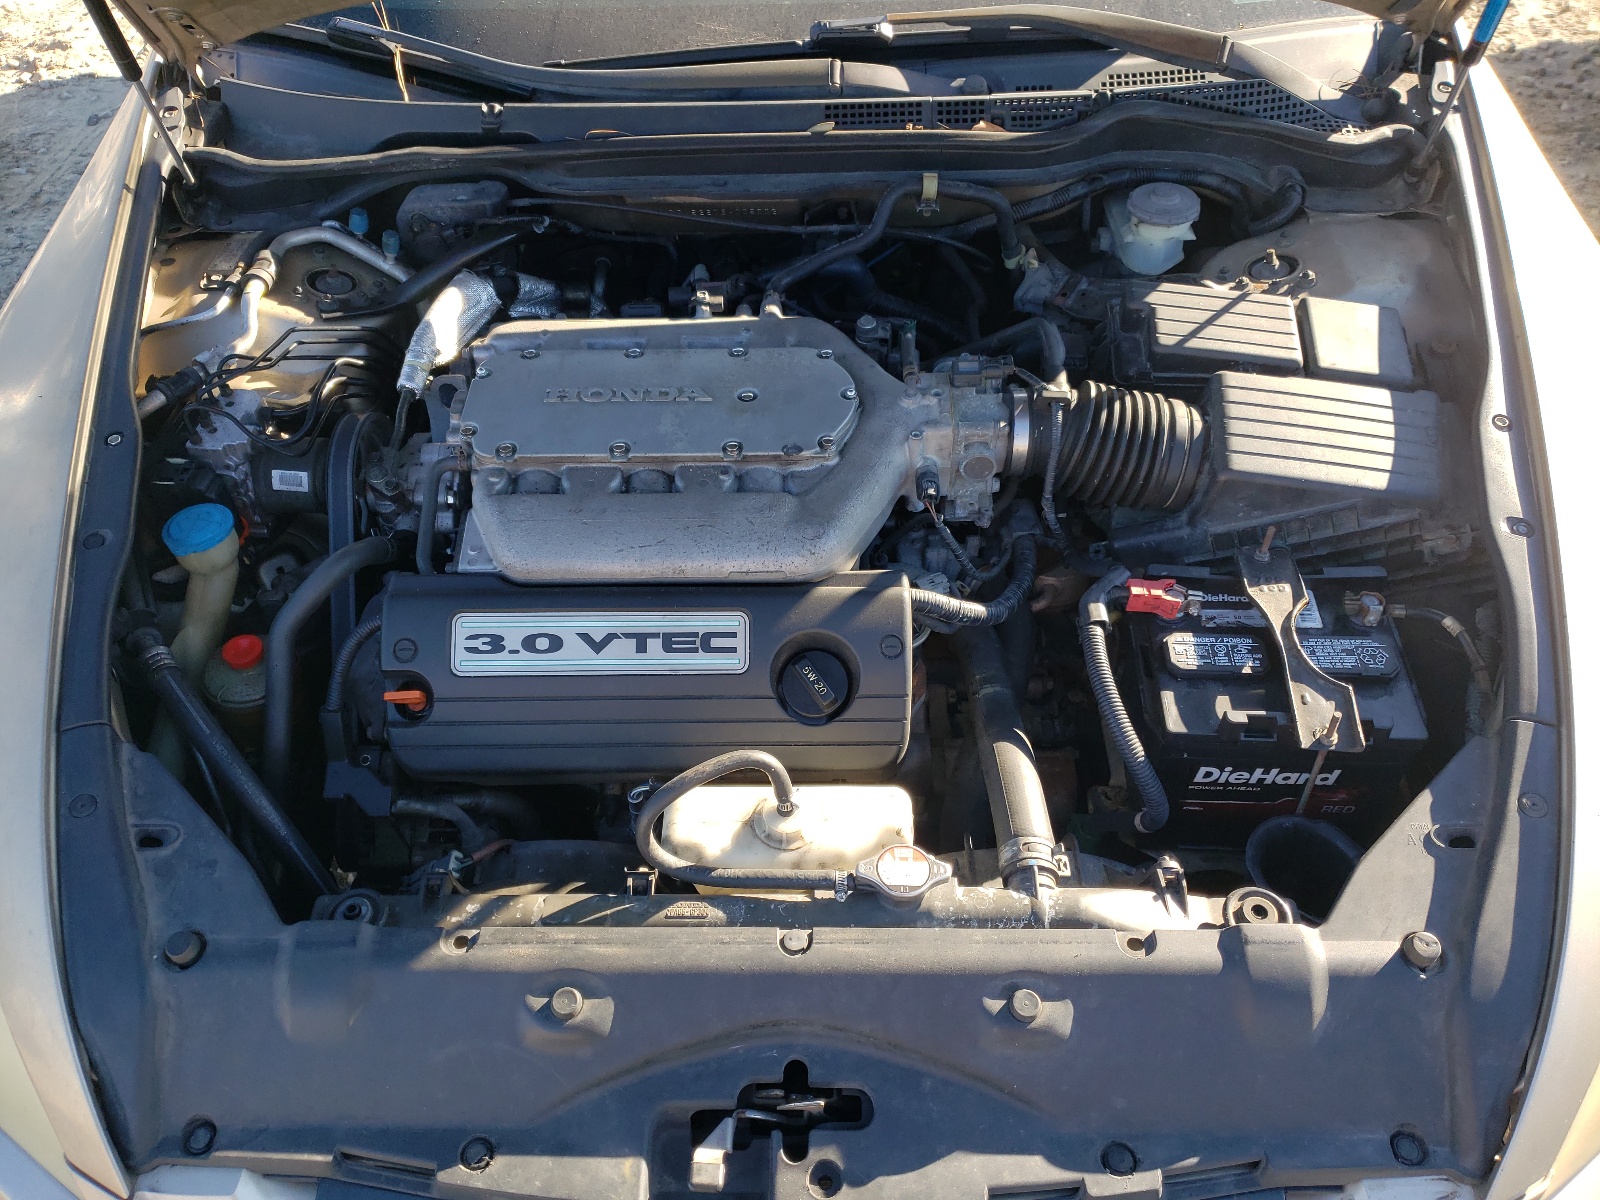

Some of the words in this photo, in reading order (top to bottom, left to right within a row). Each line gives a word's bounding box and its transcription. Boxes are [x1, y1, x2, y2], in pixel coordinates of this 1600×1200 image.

[543, 387, 714, 403] HONDA
[463, 632, 564, 655] 3.0
[574, 631, 738, 656] VTEC
[1193, 766, 1343, 786] DieHard
[1320, 805, 1356, 814] RED
